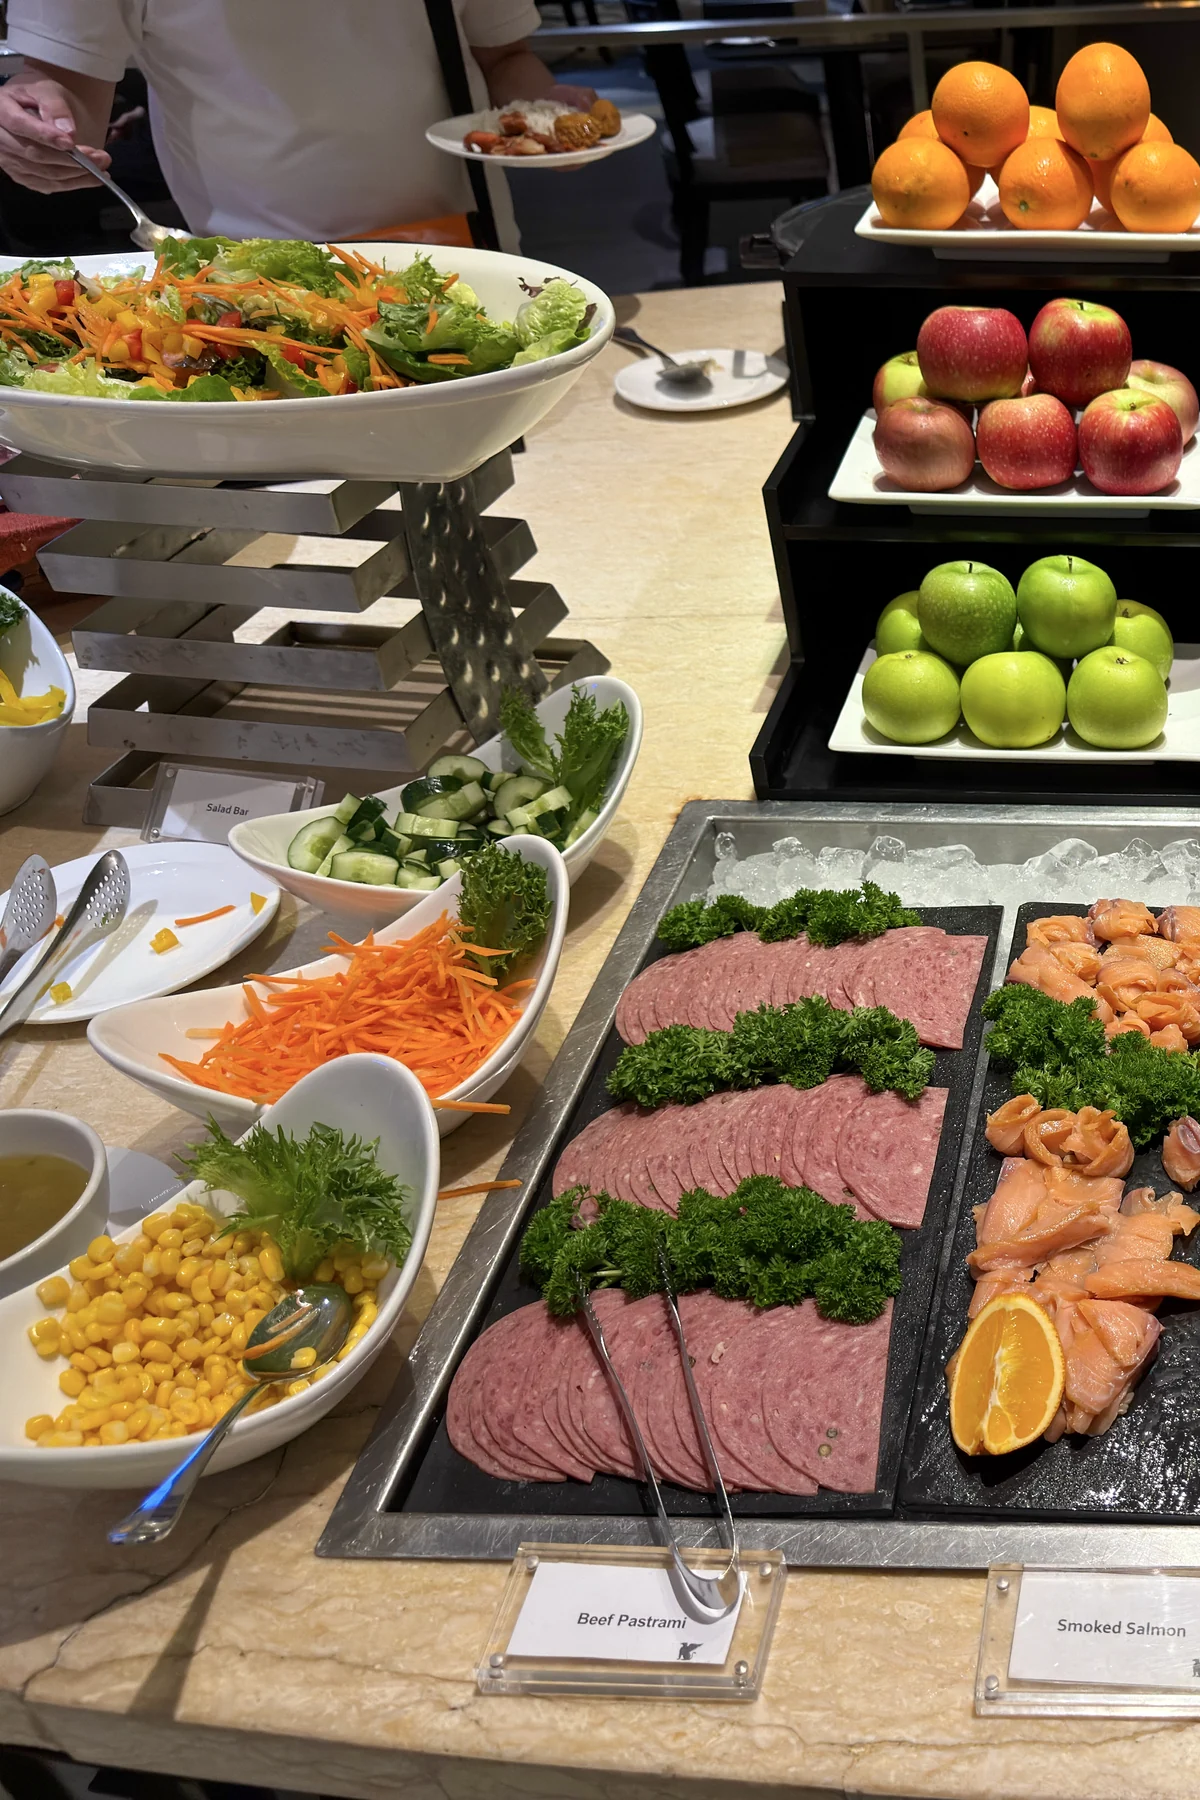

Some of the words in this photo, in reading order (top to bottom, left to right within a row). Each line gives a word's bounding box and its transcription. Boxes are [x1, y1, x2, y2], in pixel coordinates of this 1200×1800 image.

[206, 803, 232, 815] Salad
[233, 806, 249, 816] Bar
[577, 1612, 615, 1627] Beef
[617, 1614, 687, 1629] Pastrami
[1057, 1619, 1122, 1634] Smoked
[1126, 1622, 1186, 1638] Salmon
